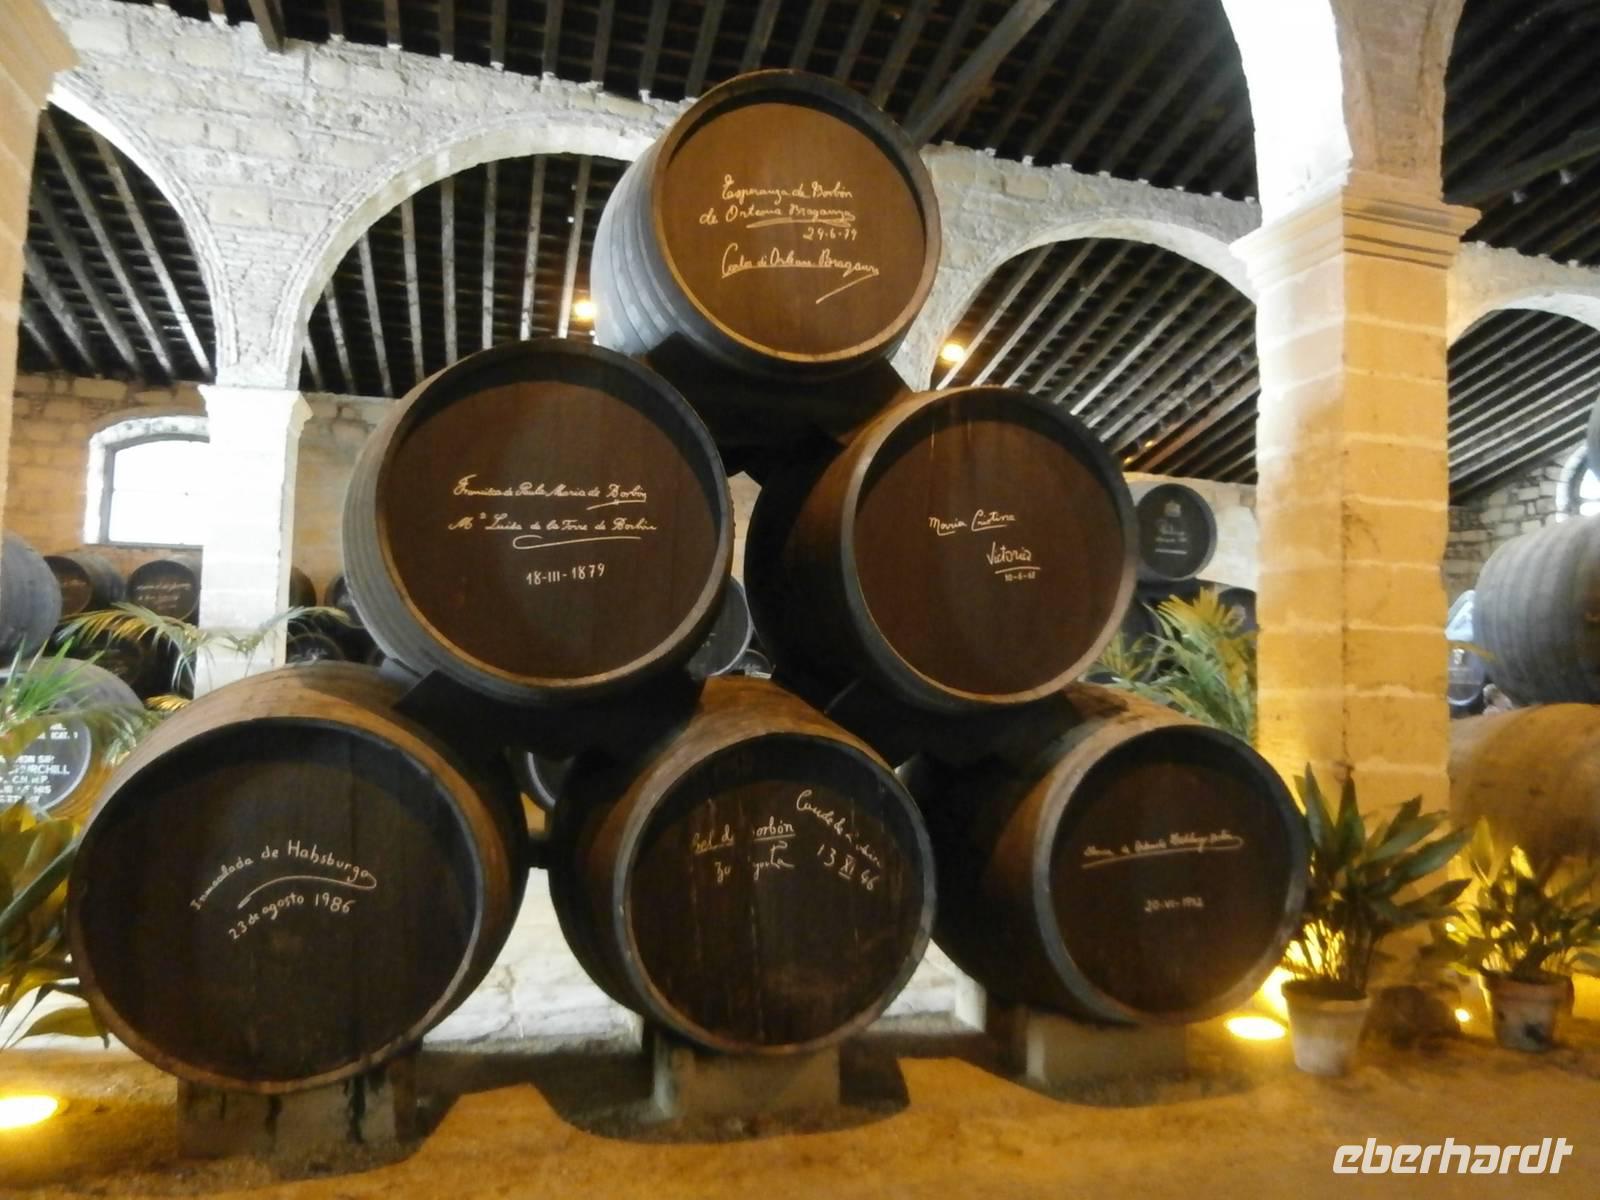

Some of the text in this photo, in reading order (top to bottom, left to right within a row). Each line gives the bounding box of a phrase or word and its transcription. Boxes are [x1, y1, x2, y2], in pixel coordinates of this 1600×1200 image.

[699, 207, 719, 225] de
[260, 845, 280, 860] de
[287, 839, 372, 883] Habsburgo
[228, 920, 248, 941] 23
[262, 891, 305, 921] agosto
[314, 891, 356, 914] 1986
